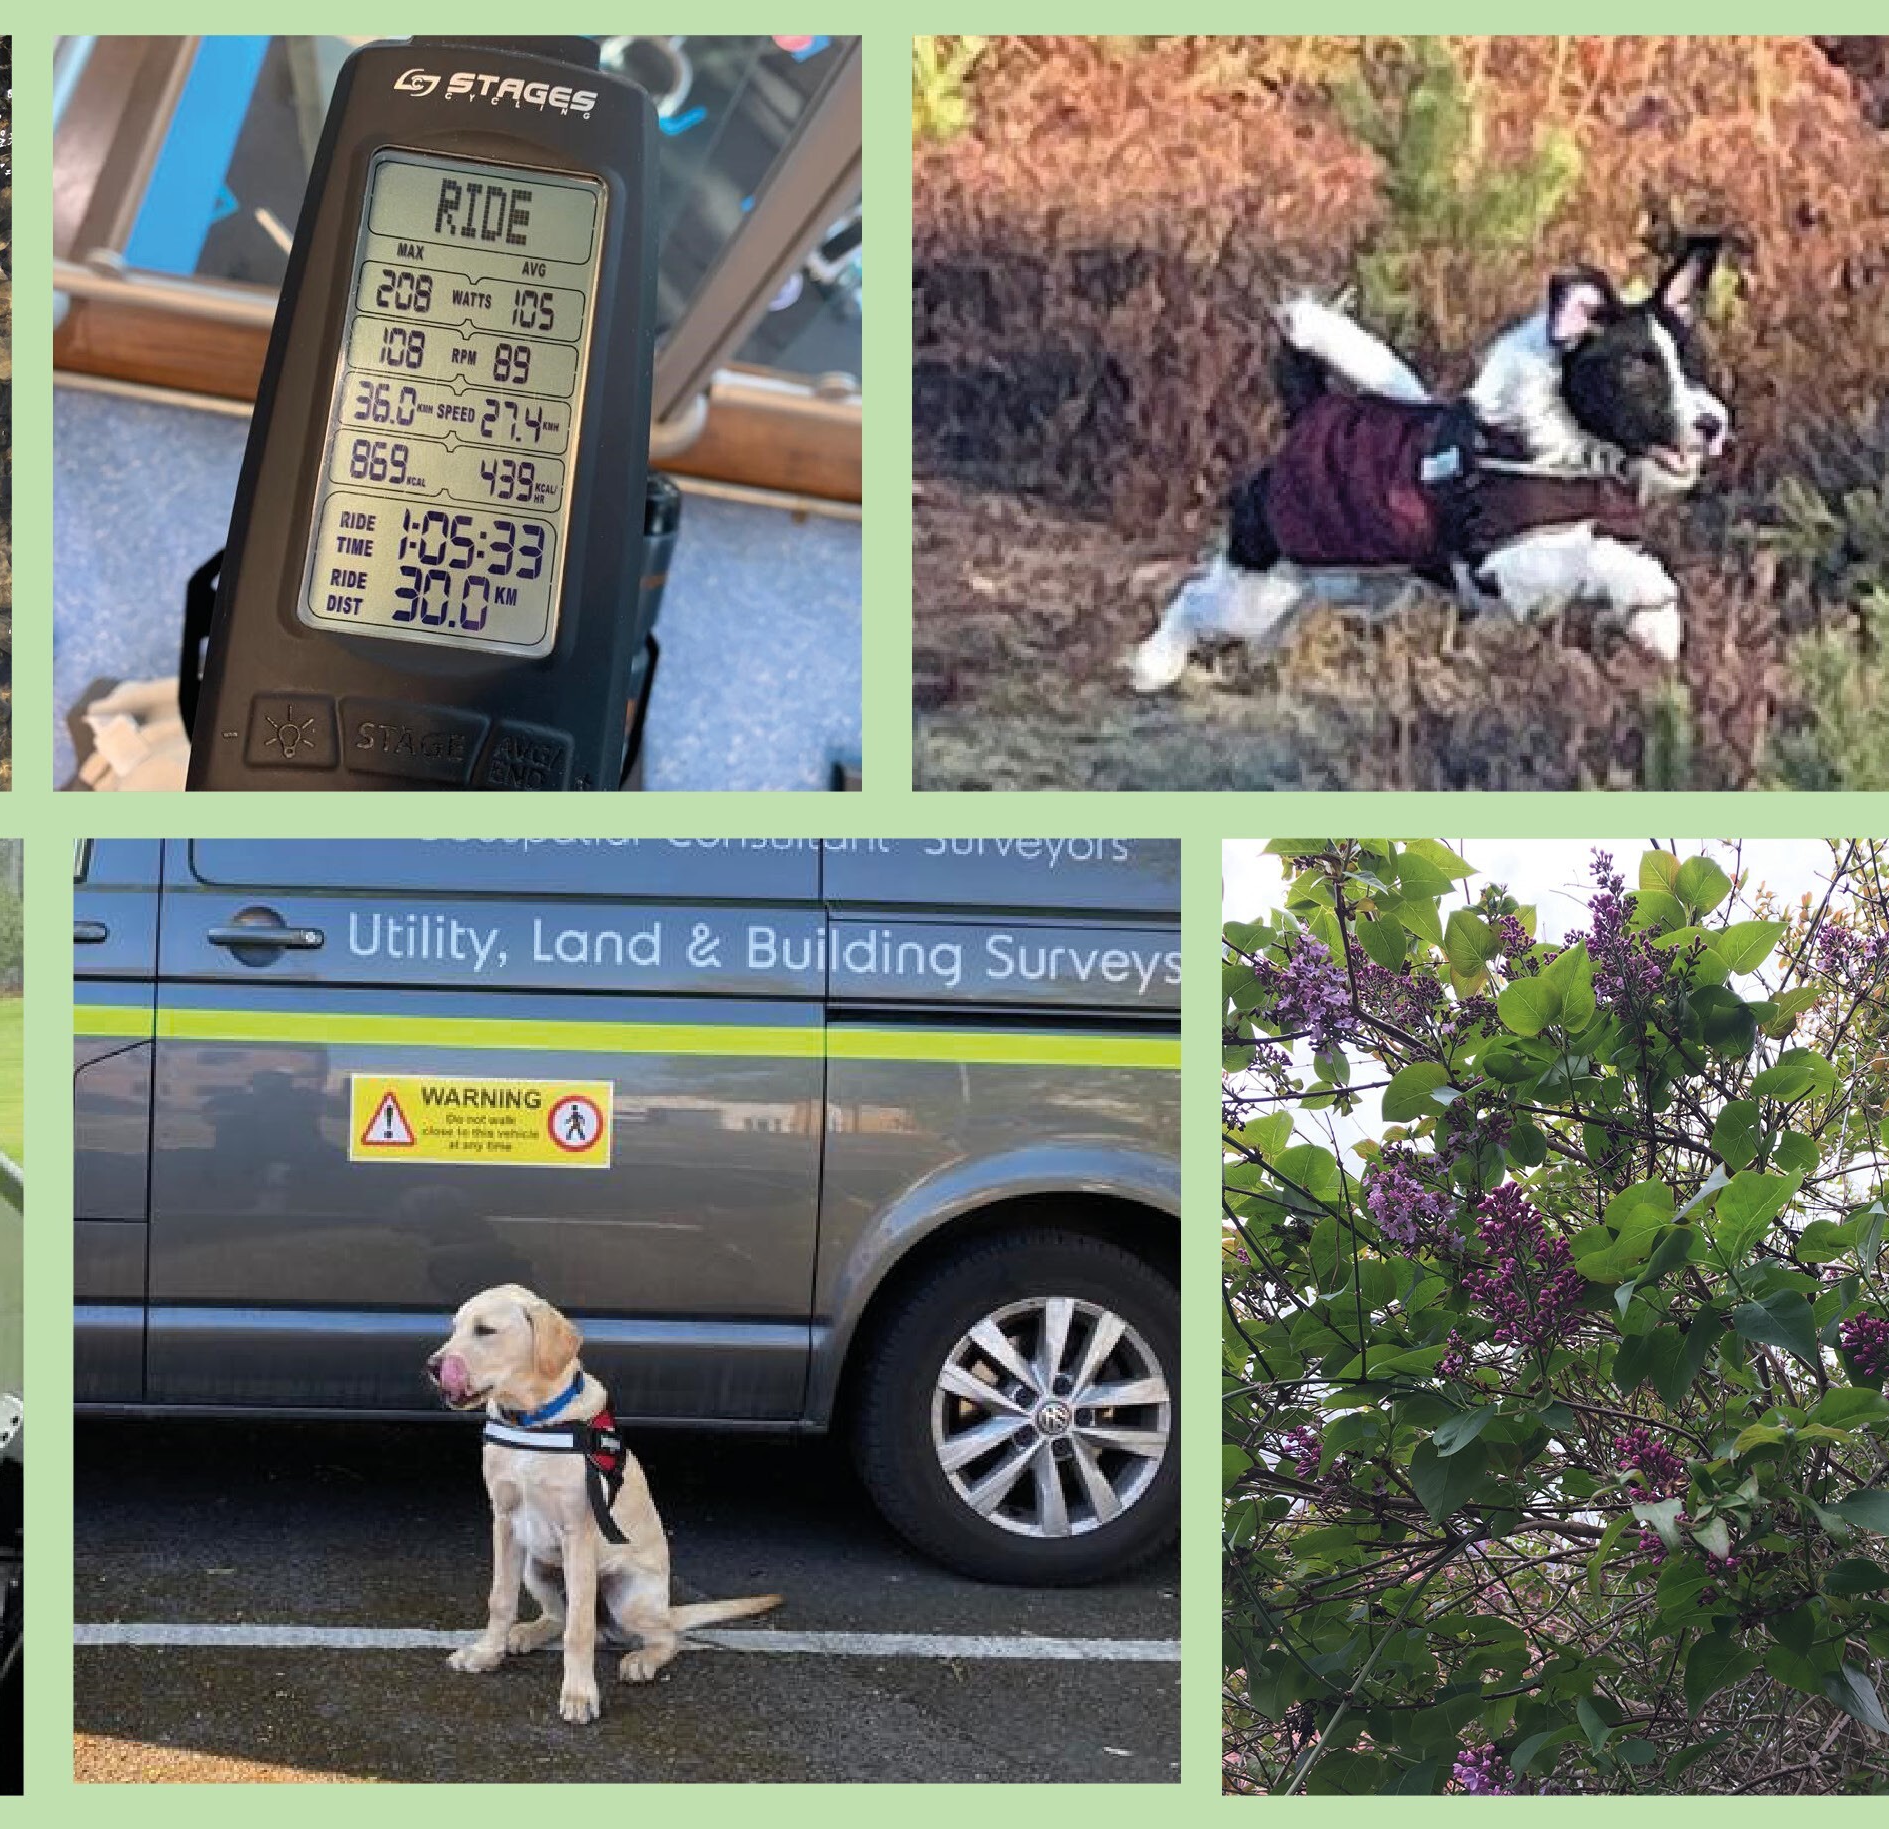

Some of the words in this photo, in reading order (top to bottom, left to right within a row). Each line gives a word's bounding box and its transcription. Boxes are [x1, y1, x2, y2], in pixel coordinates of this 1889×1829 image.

[444, 92, 591, 120] CYCLING
[447, 72, 599, 112] STAGES
[435, 178, 532, 246] RIDE
[397, 243, 424, 260] MAX
[522, 261, 546, 277] AVG
[376, 269, 433, 313] 208
[452, 289, 492, 309] WATTS
[512, 289, 554, 331] 105
[379, 327, 425, 369] 108
[451, 348, 477, 366] RPM
[493, 343, 531, 384] 89
[354, 380, 417, 426] 36.0
[416, 401, 433, 414] KMH
[436, 404, 475, 423] SPEED
[480, 399, 542, 443] 27.4
[542, 421, 560, 432] KMH
[350, 439, 409, 484] 869
[406, 475, 426, 488] KCAL
[480, 458, 535, 502] 439
[533, 494, 545, 505] HR
[339, 510, 376, 532] RIDE
[336, 536, 374, 558] TIME
[398, 508, 545, 580] 1:05:33
[330, 568, 368, 590] RIDE
[391, 565, 490, 632] 30.0
[494, 586, 518, 606] KM
[326, 594, 364, 616] DIST
[356, 721, 466, 762] STAGE
[349, 912, 507, 973] Utility,
[533, 918, 661, 967] Land
[686, 922, 722, 968] &
[747, 926, 962, 988] Building
[986, 934, 1181, 994] Surveys
[421, 1087, 541, 1110] WARNING
